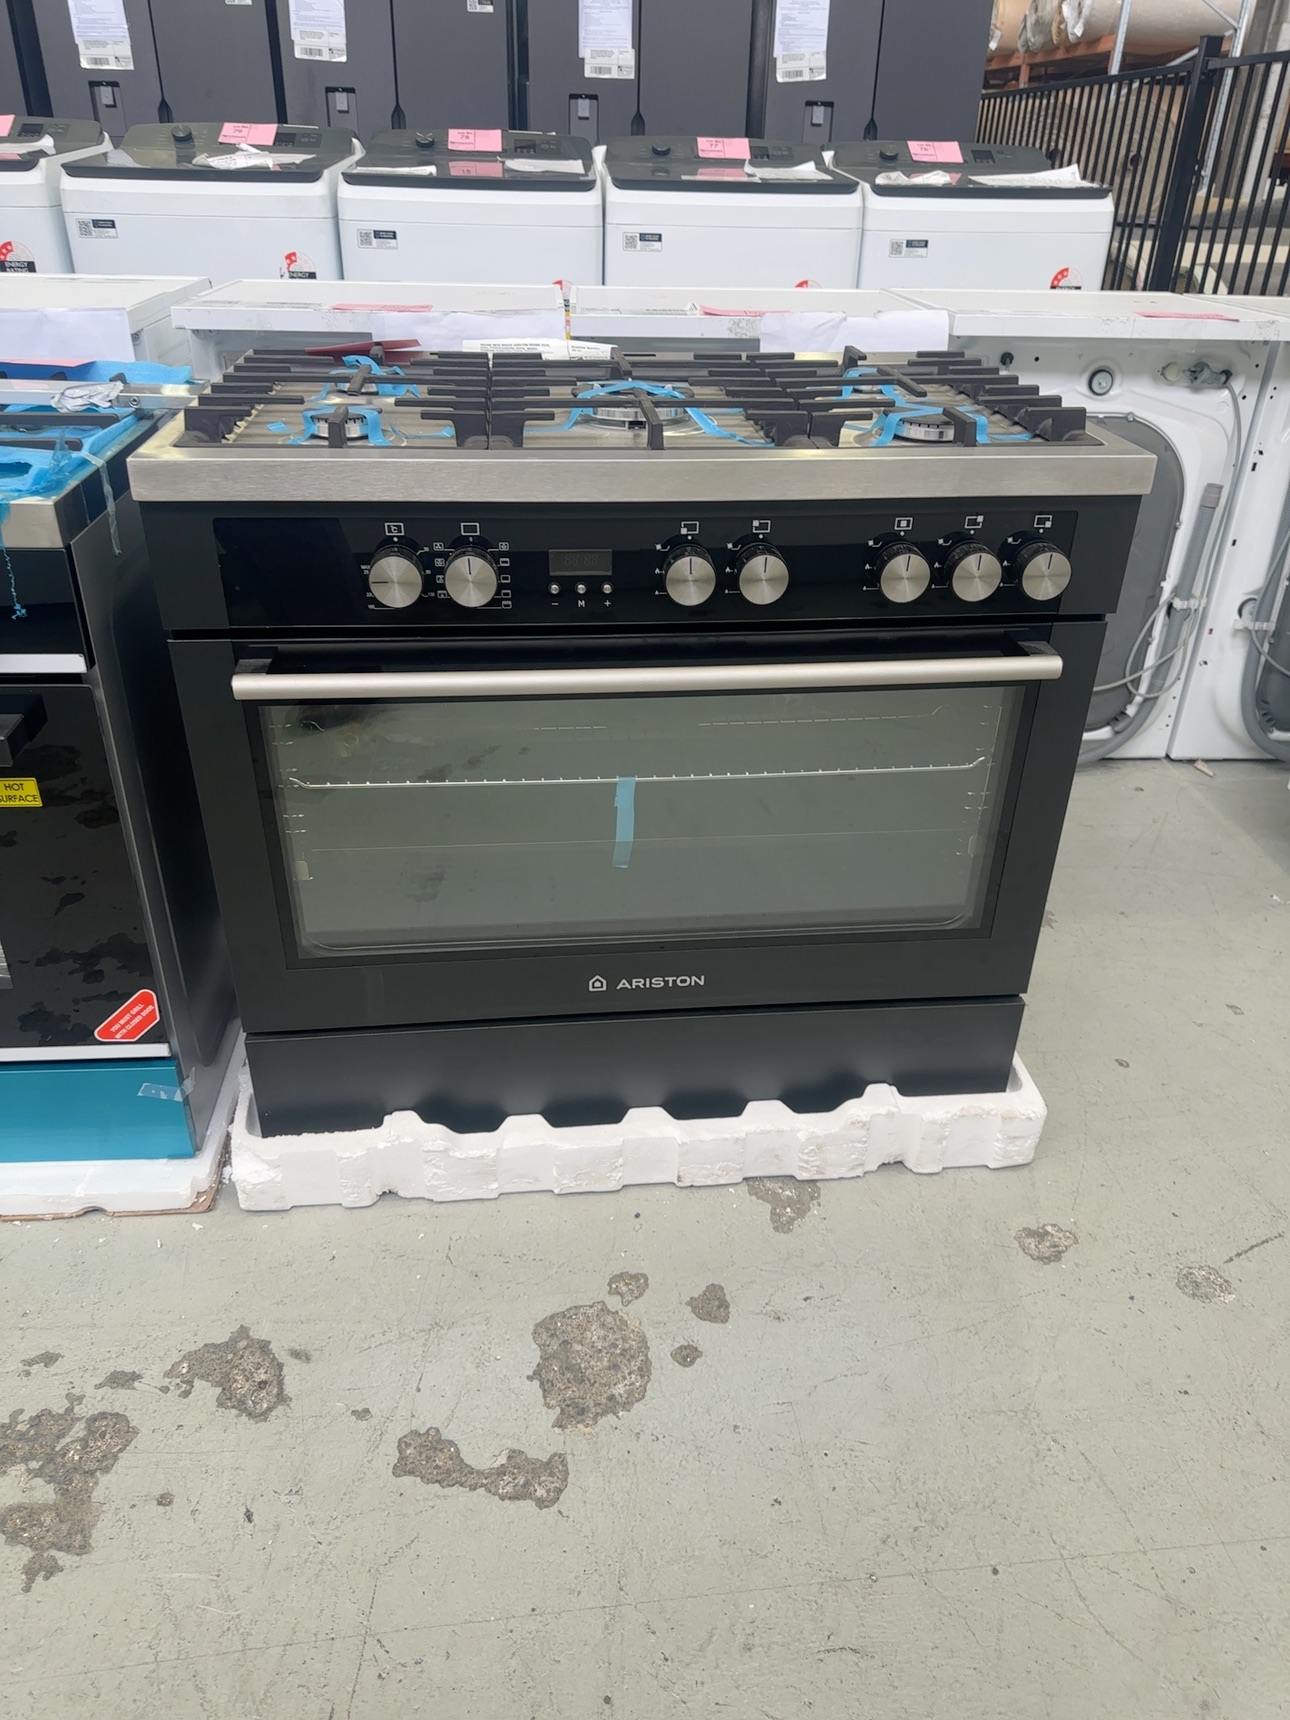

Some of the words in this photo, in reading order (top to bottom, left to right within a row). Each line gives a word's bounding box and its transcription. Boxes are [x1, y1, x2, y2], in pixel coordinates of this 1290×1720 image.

[578, 600, 586, 608] M
[4, 782, 24, 791] HOT
[616, 975, 705, 990] ARISTON
[110, 1022, 122, 1032] YOU
[119, 1013, 132, 1025] MUST
[130, 1004, 144, 1015] GRILL
[114, 1028, 128, 1039] WITH
[125, 1015, 143, 1030] CLOSED
